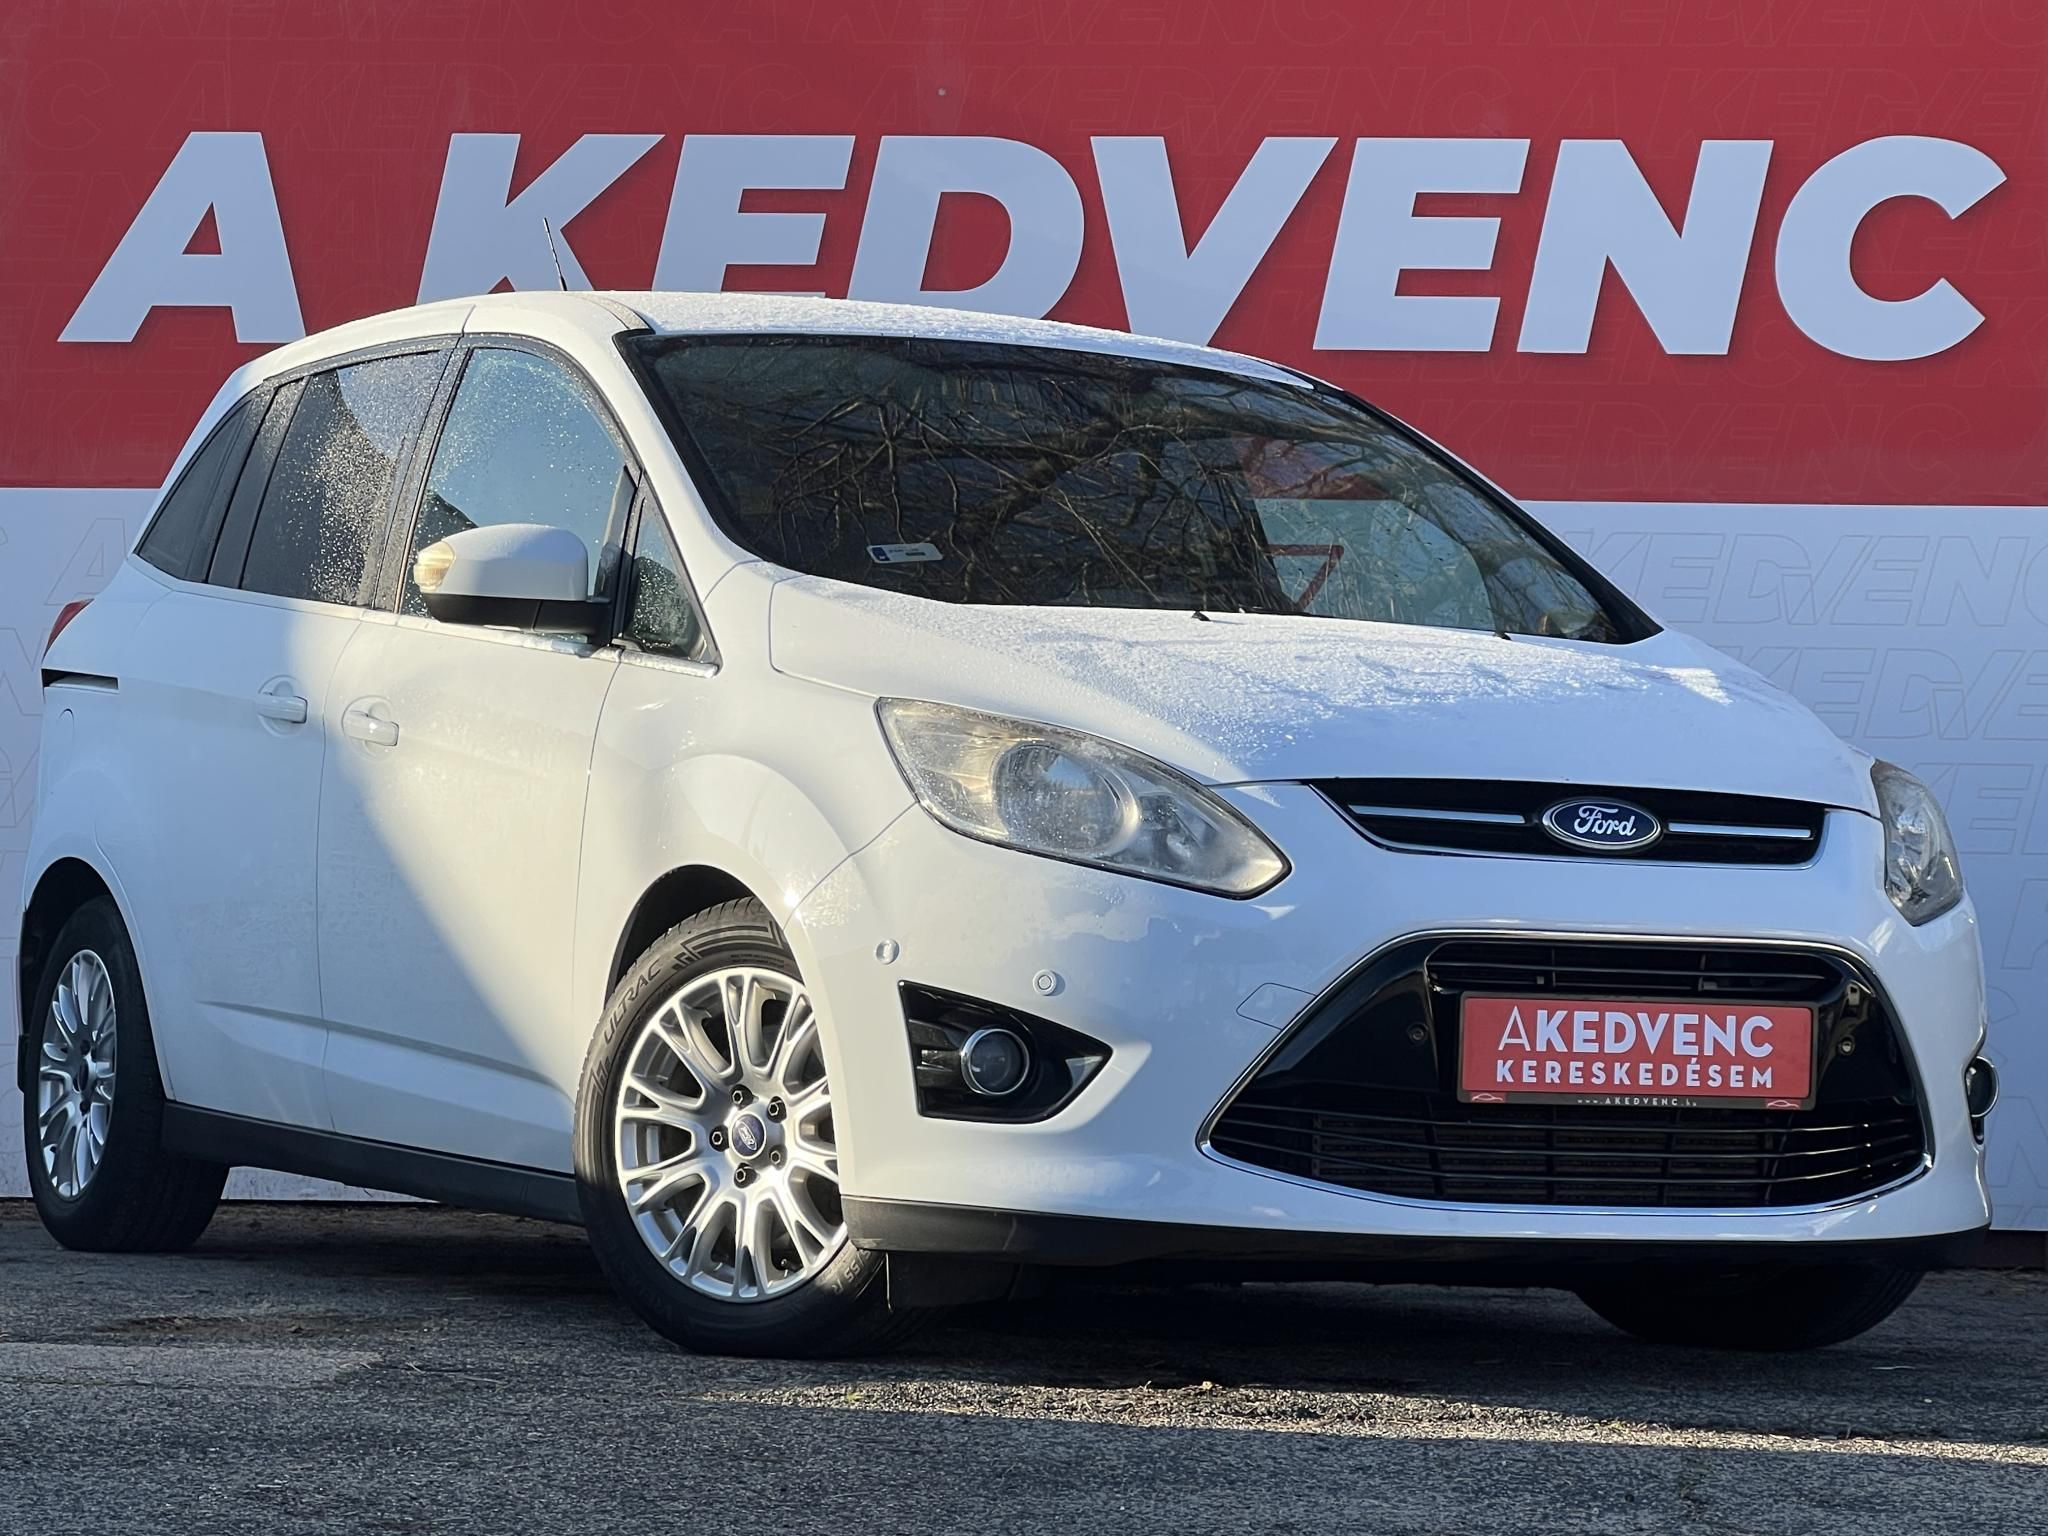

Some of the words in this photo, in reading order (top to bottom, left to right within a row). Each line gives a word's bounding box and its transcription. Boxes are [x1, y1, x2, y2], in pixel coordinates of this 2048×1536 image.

[58, 131, 305, 344] A
[418, 133, 2008, 362] KEDVENC
[1573, 805, 1636, 836] Ford
[1496, 1057, 1773, 1089] KERESKEDÉSEM
